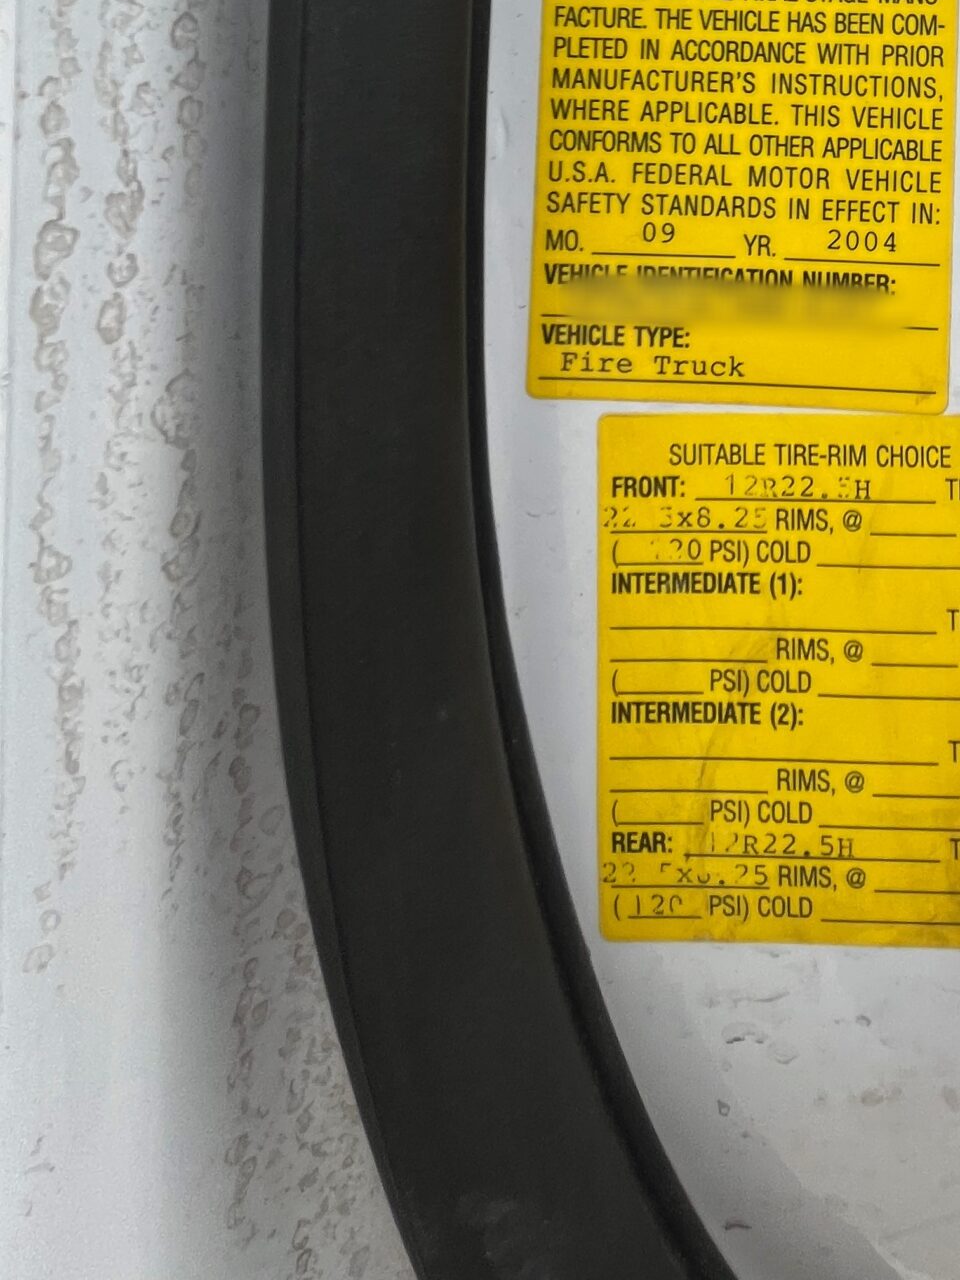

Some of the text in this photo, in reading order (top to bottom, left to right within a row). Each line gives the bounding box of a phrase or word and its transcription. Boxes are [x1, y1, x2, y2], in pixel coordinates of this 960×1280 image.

[554, 5, 945, 35] FACTURE. THE VEHICLE HAS BEEN COM-
[554, 38, 944, 67] PLETED IN ACCORDANCE WITH PRIOR
[552, 68, 943, 102] MANUFACTURER'S INSTRUCTIONS,
[550, 99, 943, 130] WHERE APPLICABLE. THIS VEHICLE
[550, 130, 942, 162] CONFORMS TO ALL OTHER APPLICABLE
[549, 161, 941, 193] U.S.A. FEDERAL MOTOR VEHICLE
[547, 193, 940, 225] SAFETY STANDARDS IN EFFECT IN:
[546, 222, 897, 257] MO. 09 YR. 2004
[802, 270, 895, 295] NUMBER:
[542, 324, 690, 349] VEHICLE TYPE:
[561, 352, 745, 378] Fire Truck
[669, 444, 951, 468] SUITABLE TIRE-RIM CHOICE
[612, 476, 685, 498] FRONT:
[776, 508, 834, 534] RIMS,
[710, 541, 810, 566] PSI) COLD
[612, 573, 803, 599] INTERMEDIATE (1):
[776, 639, 834, 664] RIMS,
[710, 670, 811, 695] PSI) COLD
[612, 703, 804, 730] INTERMEDIATE (2):
[777, 769, 835, 795] RIMS,
[710, 801, 812, 826] PSI) COLD
[612, 833, 672, 853] REAR:
[779, 865, 837, 890] RIMS,
[710, 896, 812, 921] PSI) COLD
